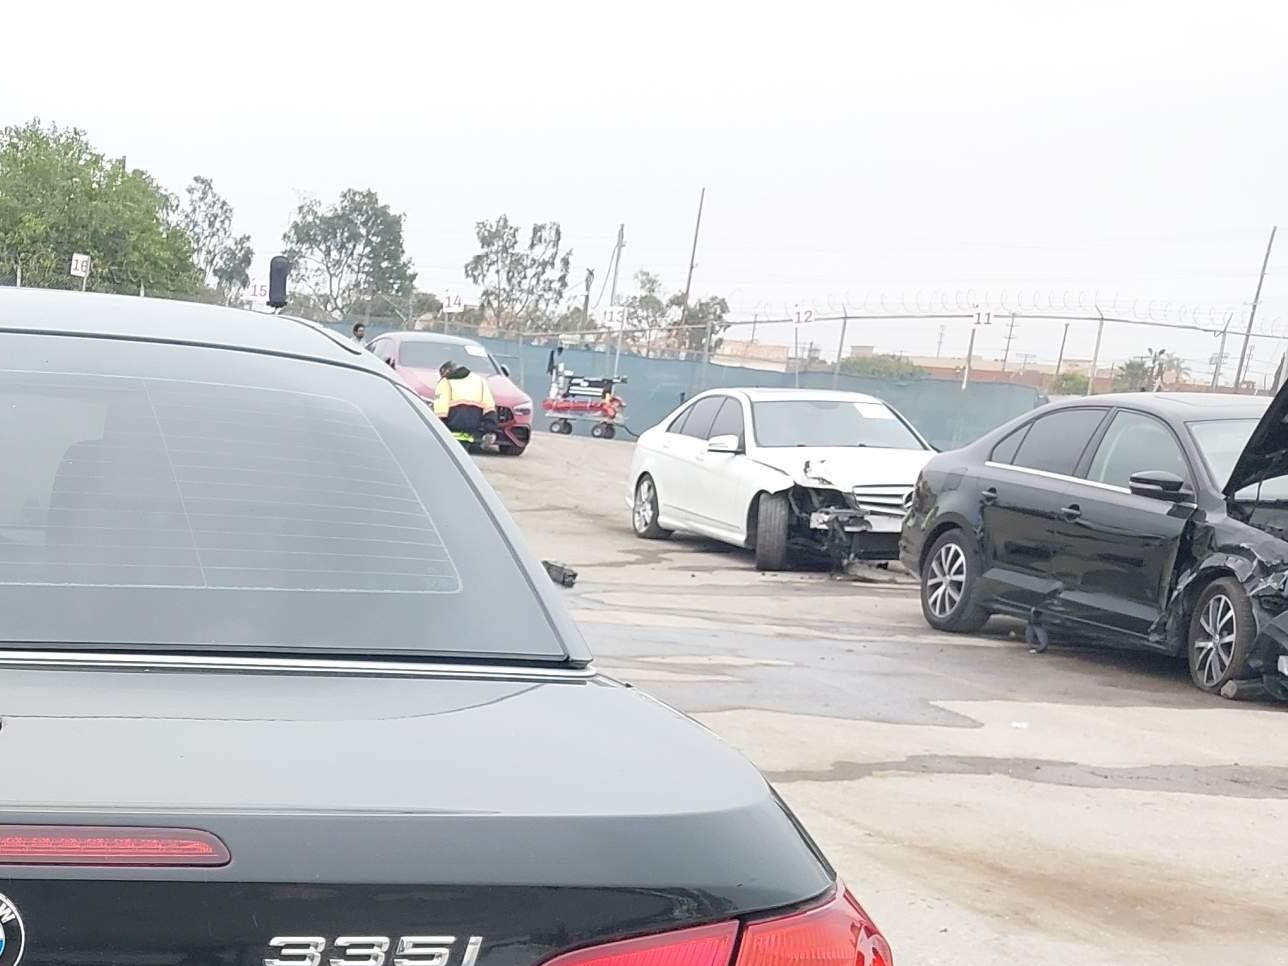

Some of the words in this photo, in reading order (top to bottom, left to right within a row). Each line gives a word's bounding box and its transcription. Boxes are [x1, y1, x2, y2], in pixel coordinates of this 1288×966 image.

[72, 258, 89, 273] 16
[250, 284, 268, 297] 15
[444, 295, 463, 308] 14
[794, 310, 813, 324] 12
[973, 311, 993, 325] 11
